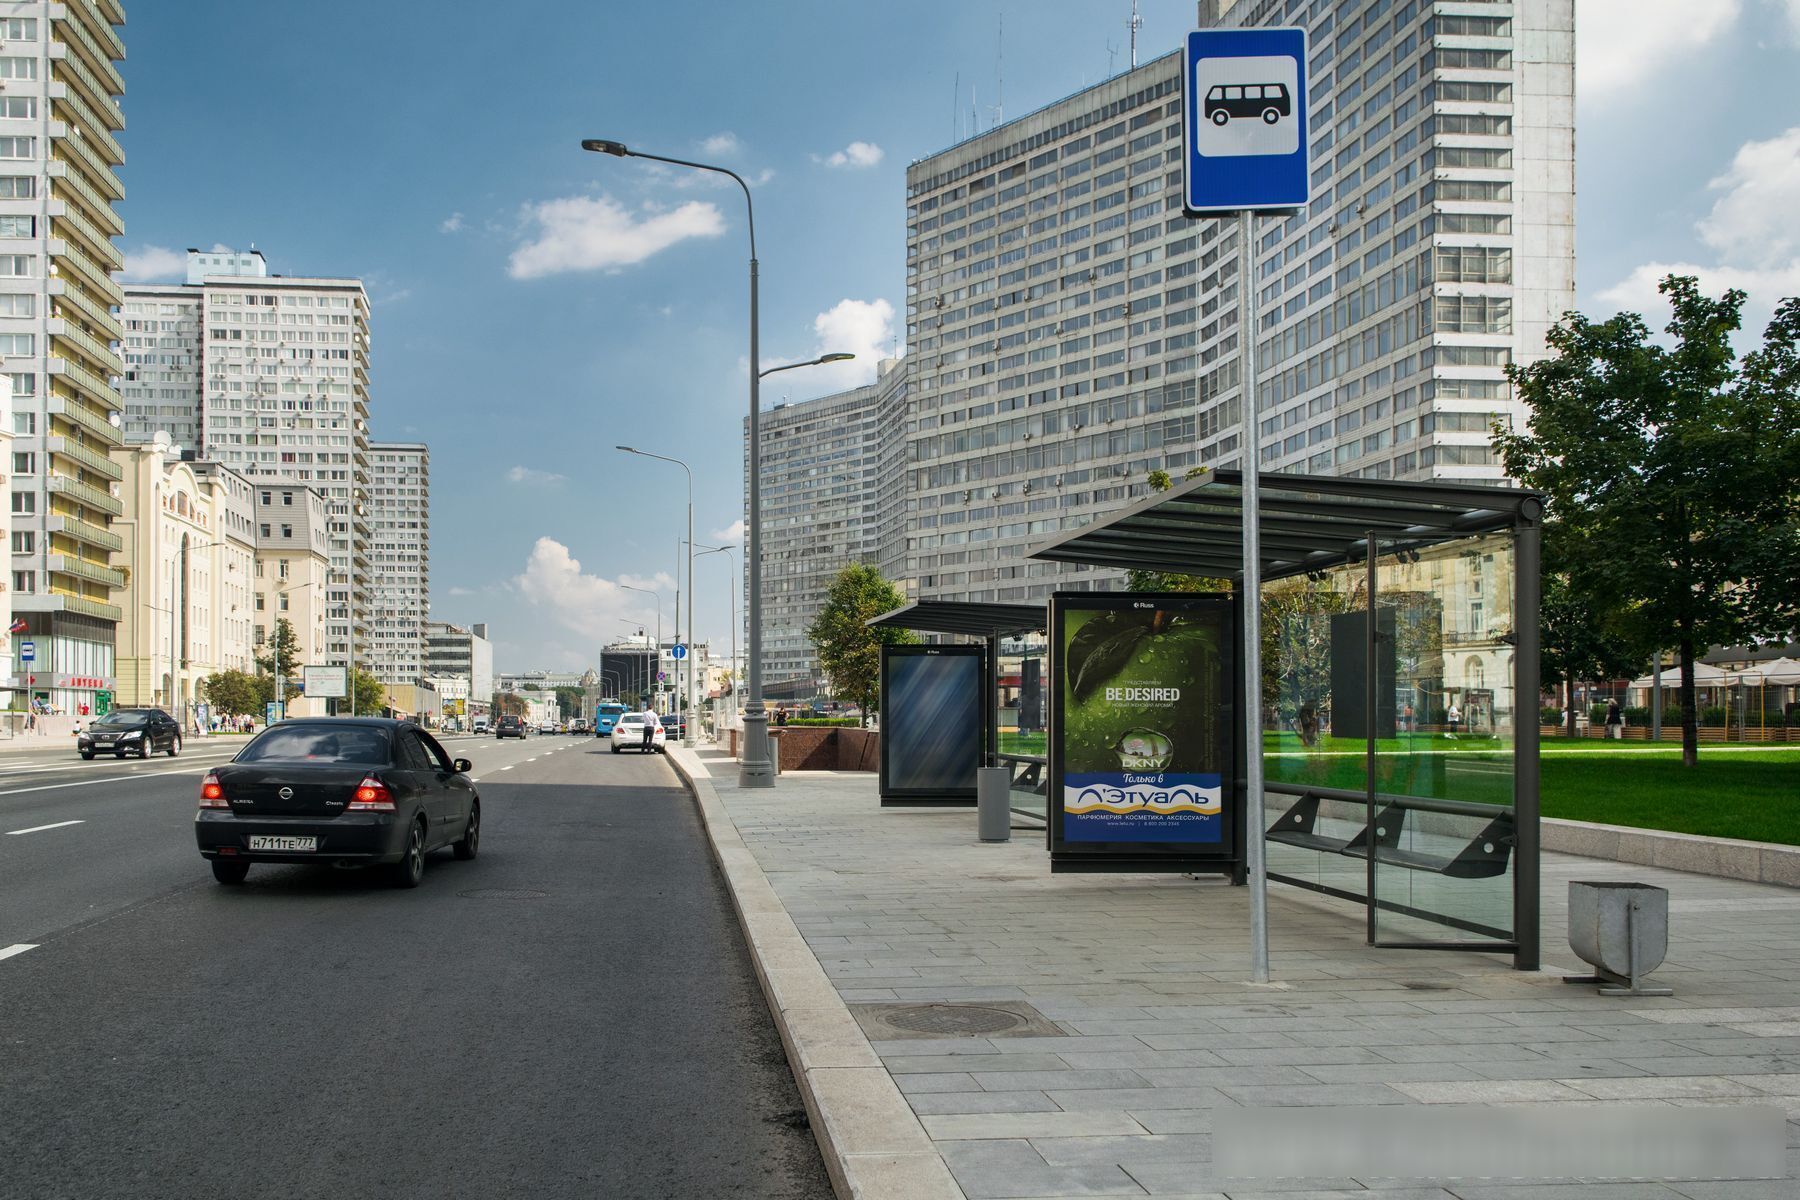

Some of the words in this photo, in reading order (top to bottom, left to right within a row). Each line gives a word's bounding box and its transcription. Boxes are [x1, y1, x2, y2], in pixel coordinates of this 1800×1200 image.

[70, 678, 103, 688] АПТЕКА
[1106, 688, 1122, 700] BE
[1125, 688, 1180, 701] DESIRED
[1122, 759, 1165, 768] DKNY
[1123, 774, 1156, 783] Только
[1157, 774, 1164, 783] в
[297, 838, 313, 846] 777
